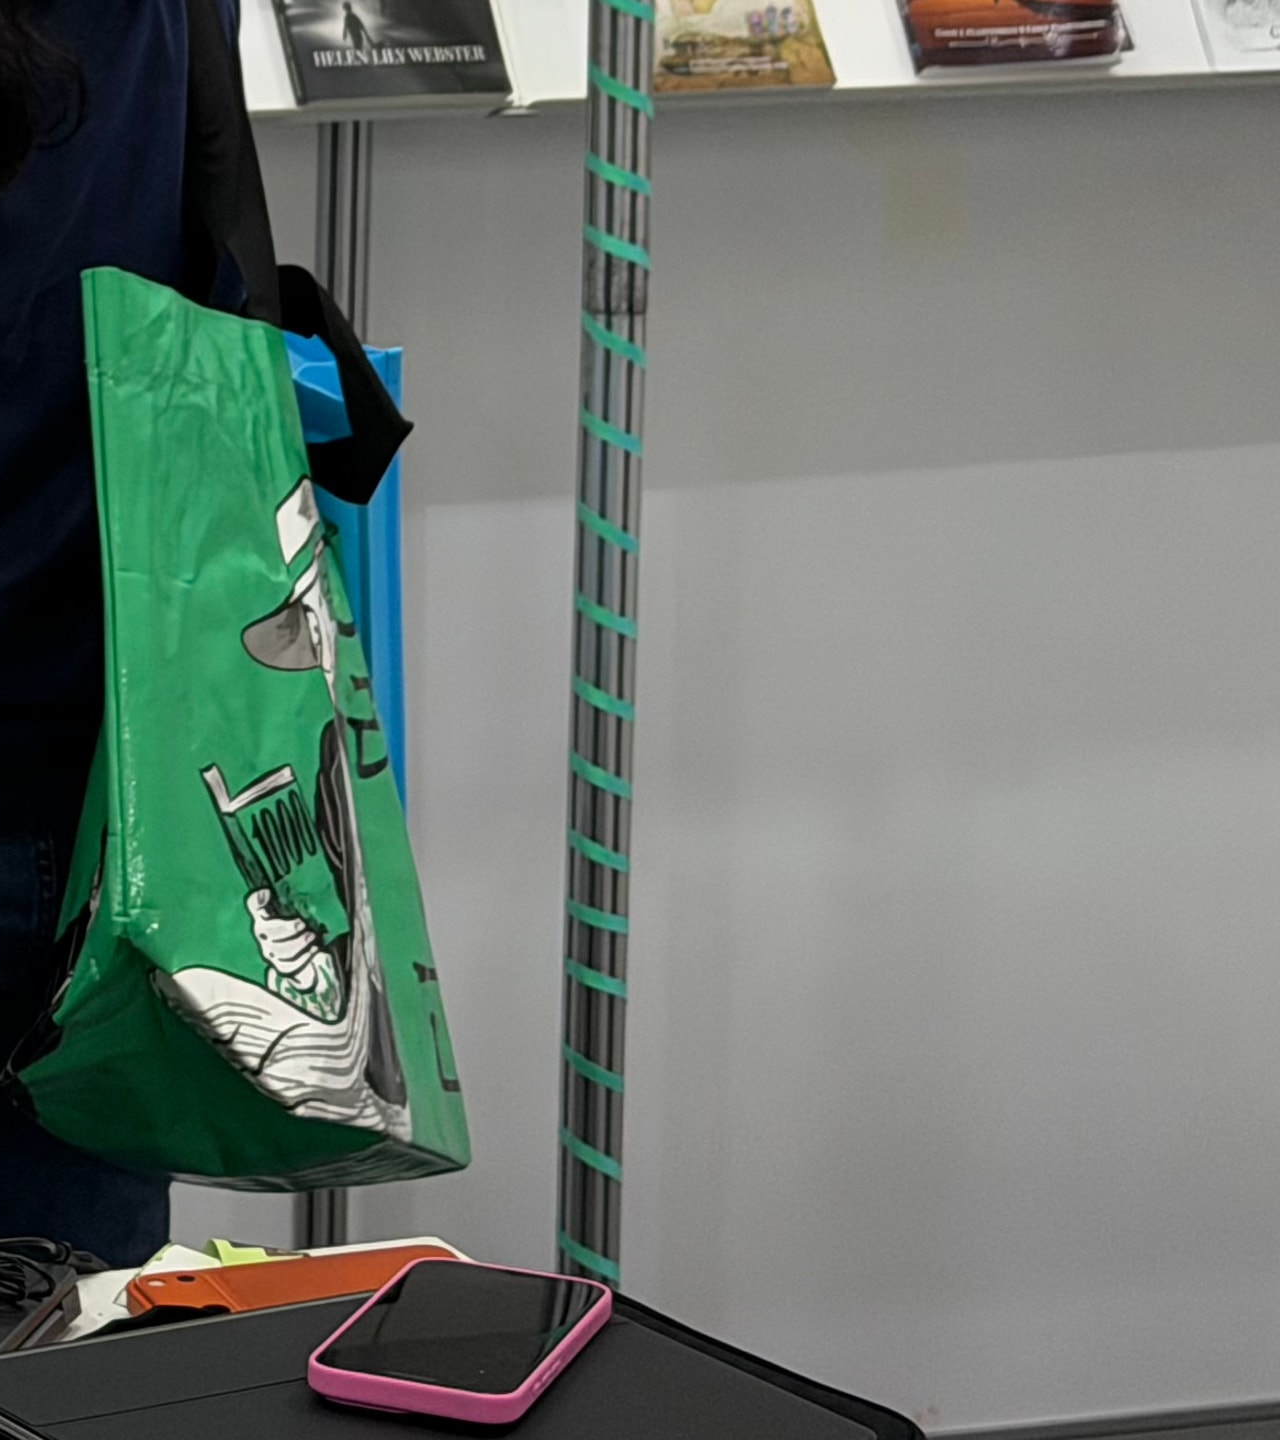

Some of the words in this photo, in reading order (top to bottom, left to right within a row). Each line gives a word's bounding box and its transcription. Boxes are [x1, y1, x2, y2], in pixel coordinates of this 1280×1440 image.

[313, 50, 370, 68] HELEN
[407, 44, 486, 64] WEBSTER
[252, 788, 317, 883] 1000
